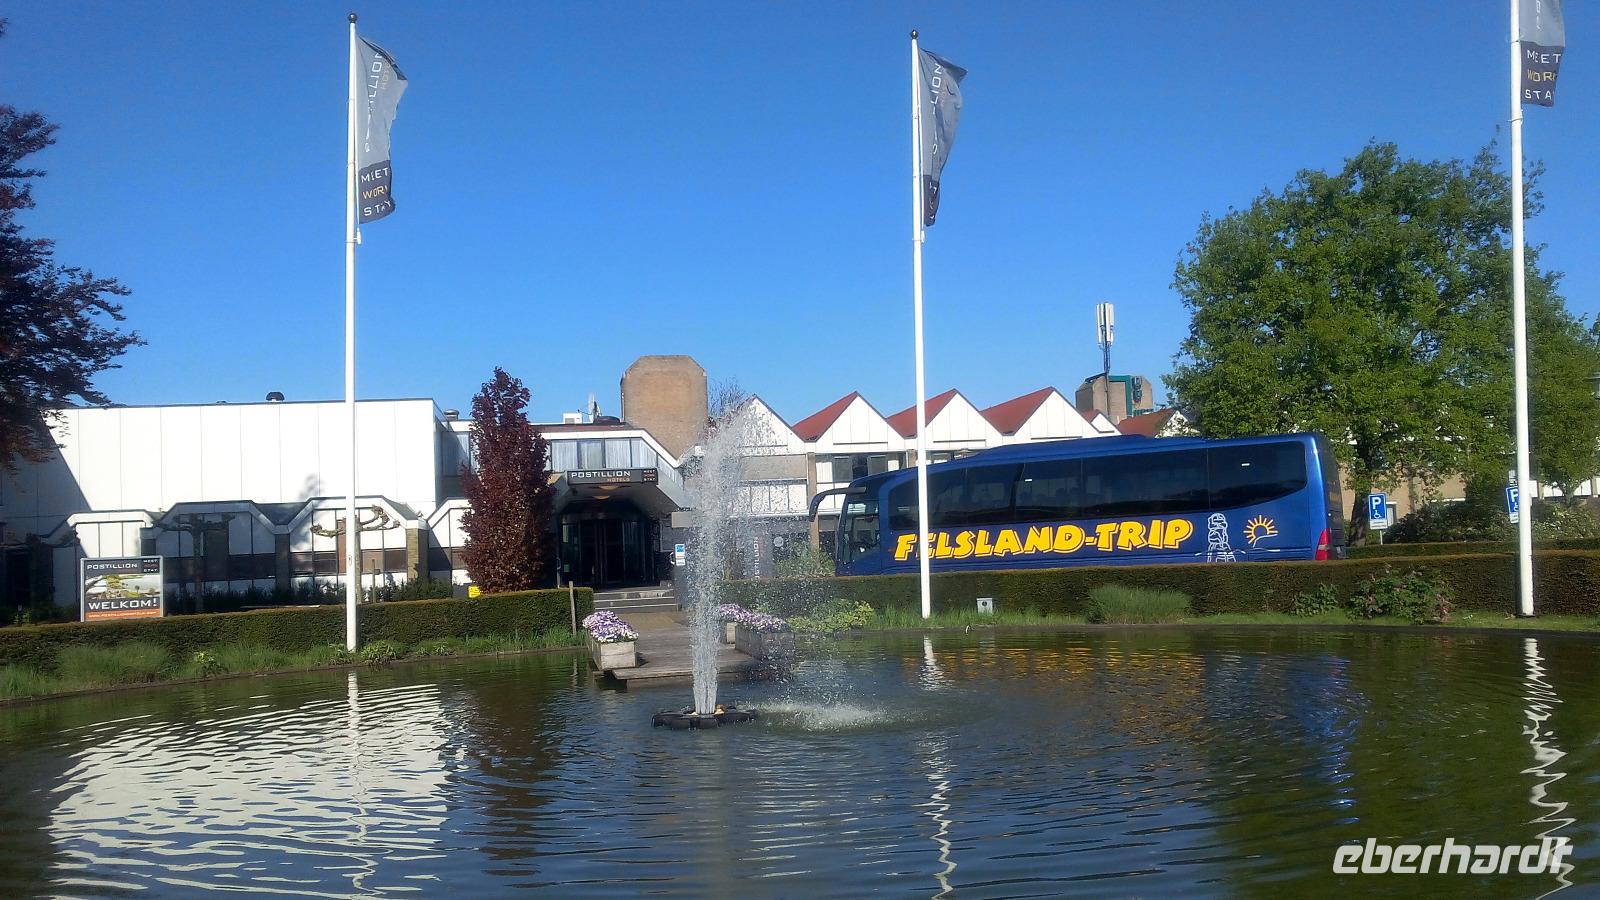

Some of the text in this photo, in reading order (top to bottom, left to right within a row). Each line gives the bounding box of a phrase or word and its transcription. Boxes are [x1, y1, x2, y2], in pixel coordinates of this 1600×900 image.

[1525, 88, 1555, 100] STA
[571, 470, 631, 478] POSTILLION
[1371, 496, 1381, 510] P
[88, 598, 158, 610] WELKOM!
